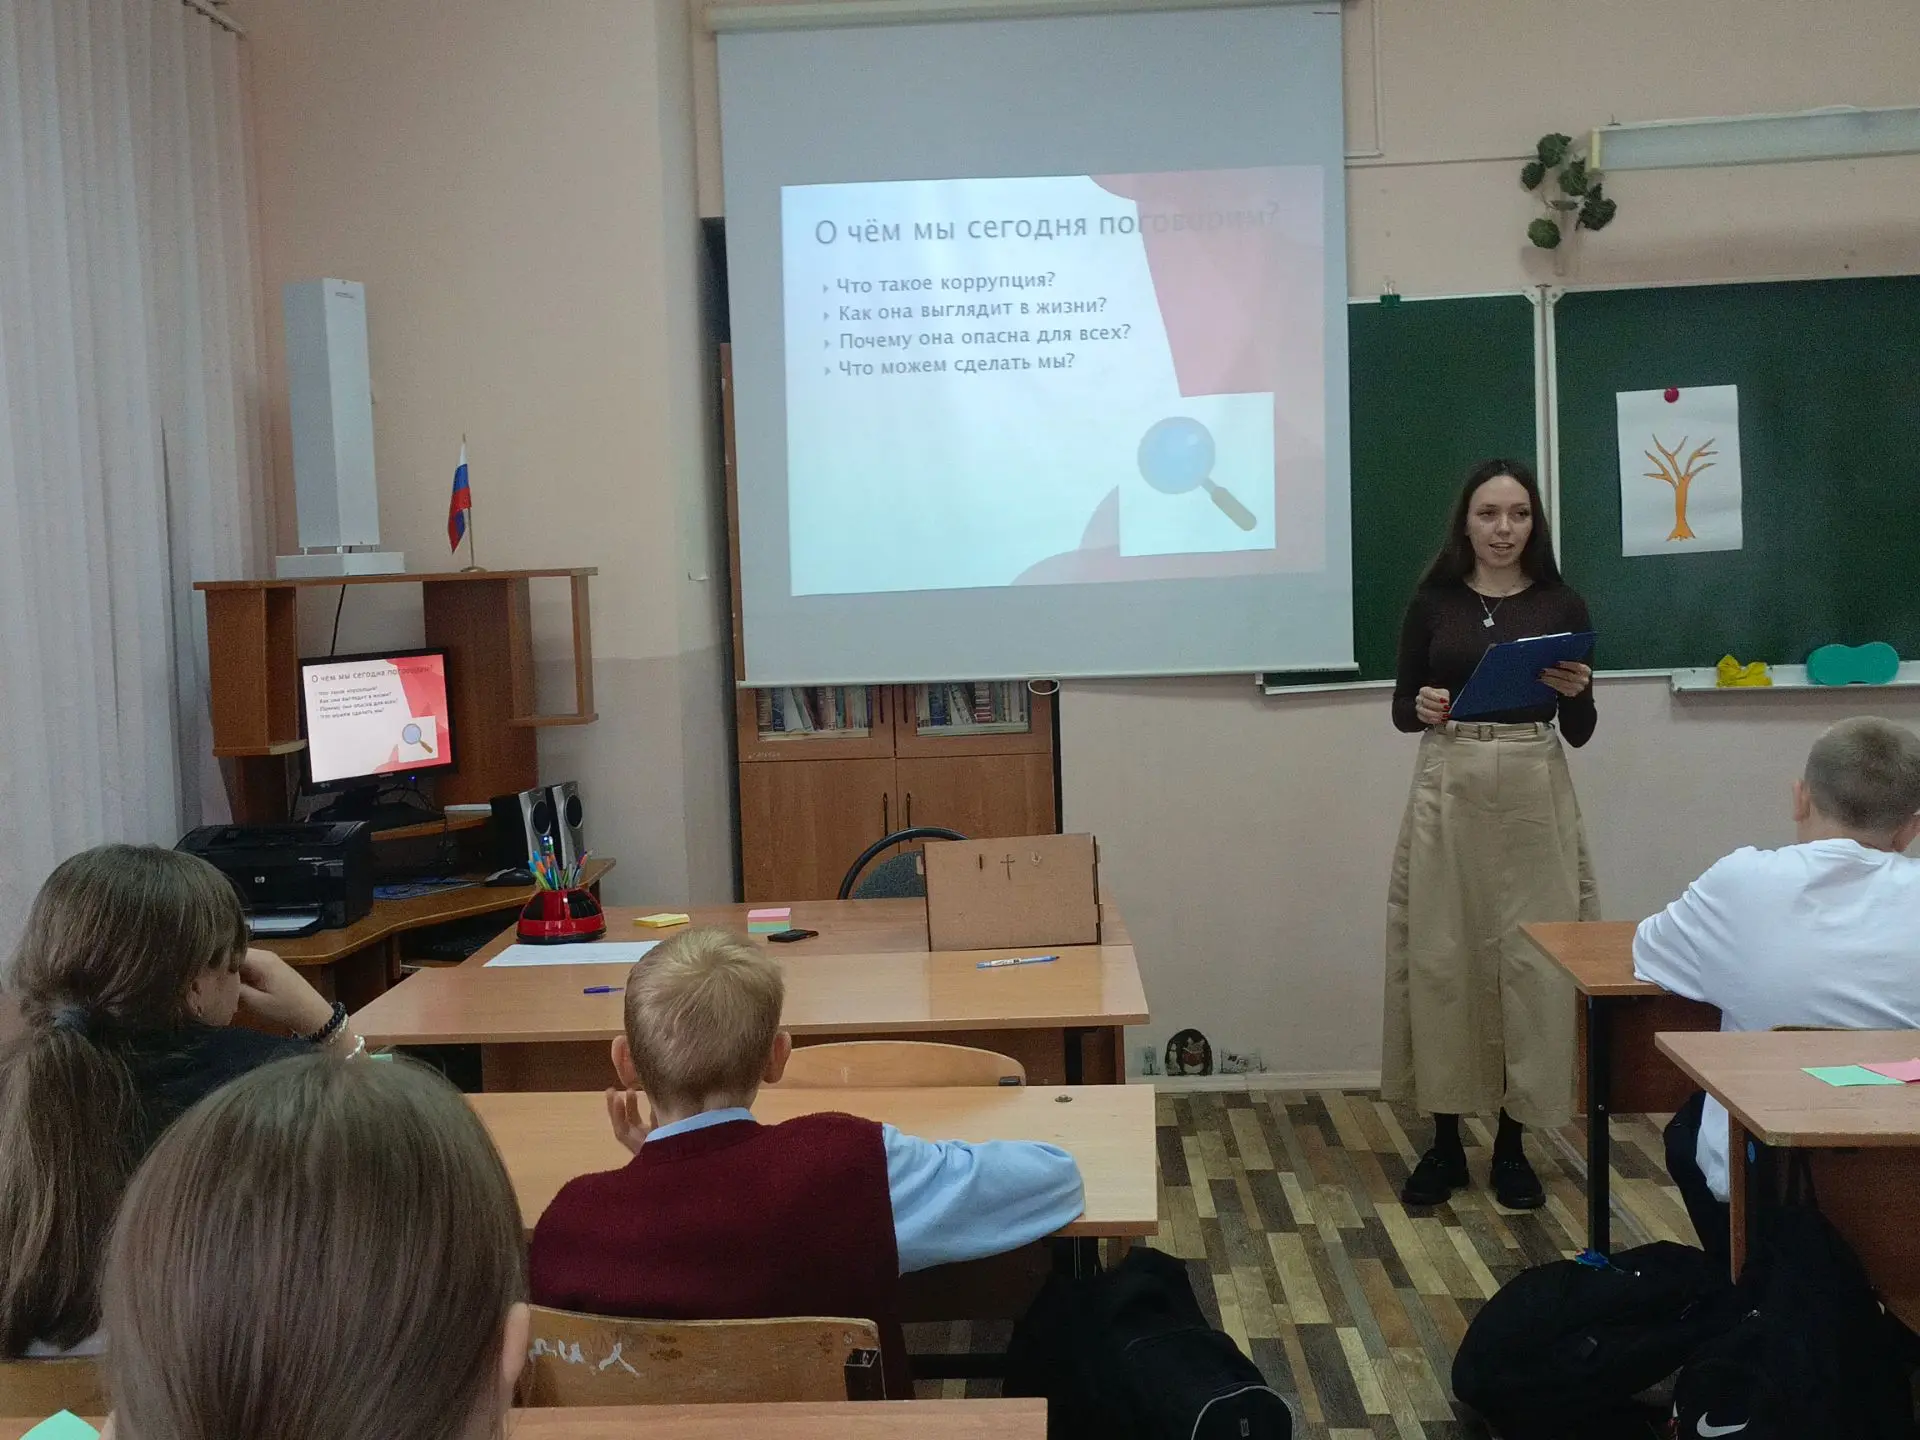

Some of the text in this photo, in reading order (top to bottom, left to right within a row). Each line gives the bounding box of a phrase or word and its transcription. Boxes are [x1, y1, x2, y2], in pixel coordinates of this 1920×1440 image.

[815, 219, 837, 244] О
[847, 217, 901, 242] чём
[913, 221, 955, 241] мы
[967, 216, 1087, 241] сегодня
[836, 270, 1056, 294] Что такое коррупция?
[839, 296, 1107, 321] Как она выглядит в жизни?
[839, 323, 1132, 351] Почему она опасна для всех?
[839, 352, 1075, 377] Что можем сделать мы?
